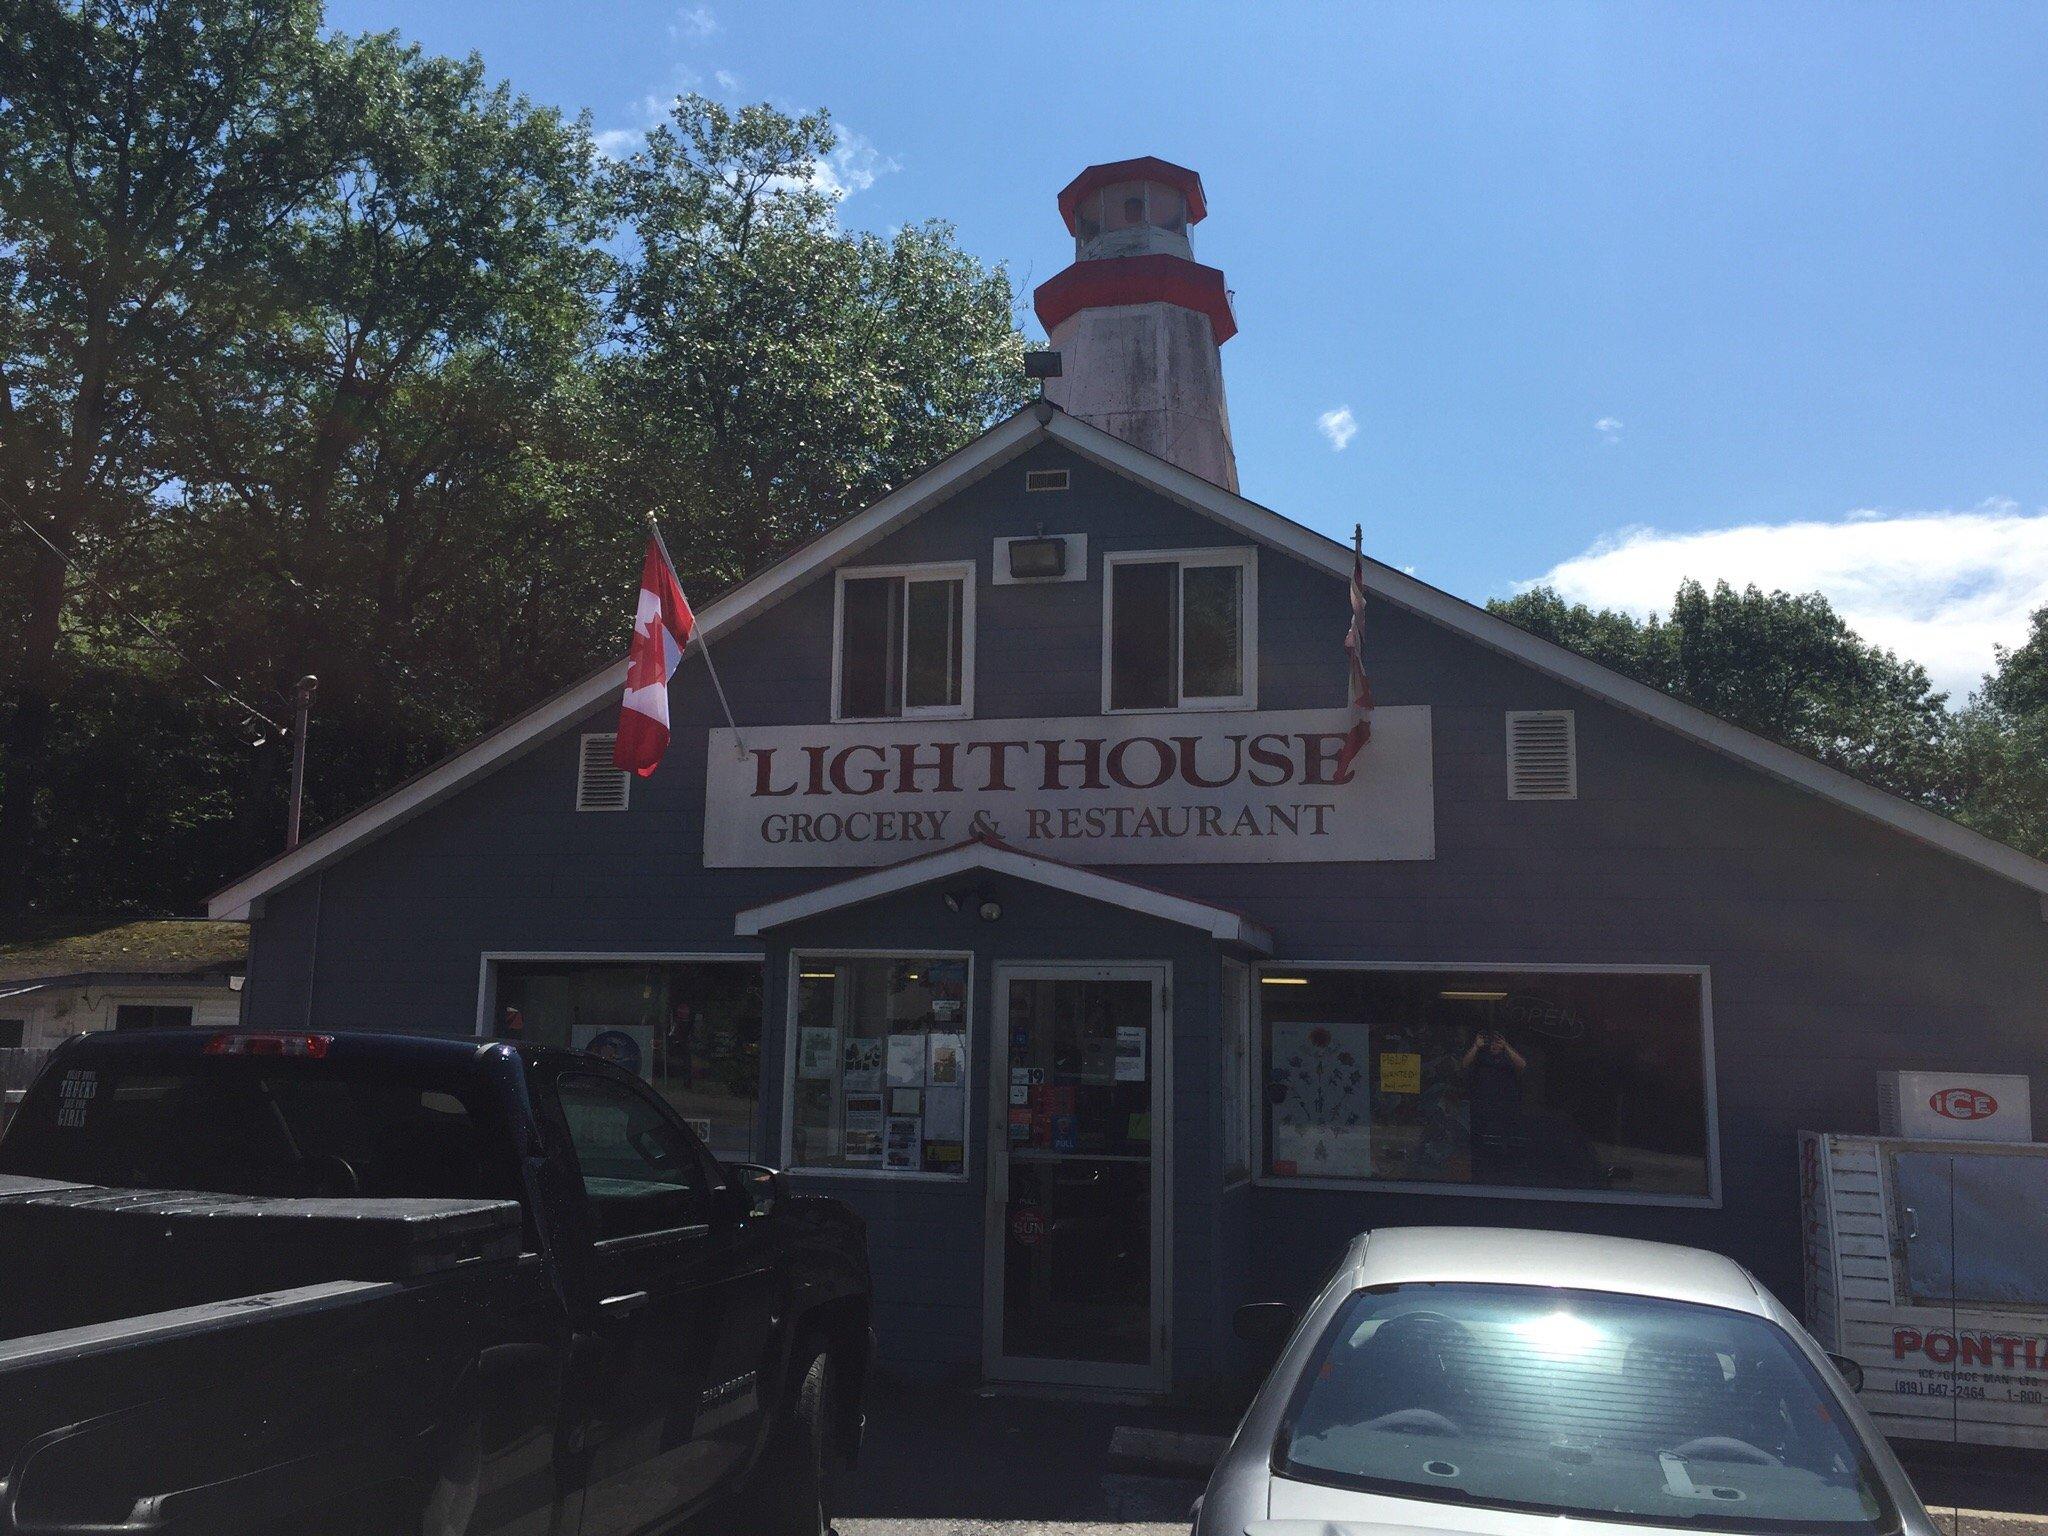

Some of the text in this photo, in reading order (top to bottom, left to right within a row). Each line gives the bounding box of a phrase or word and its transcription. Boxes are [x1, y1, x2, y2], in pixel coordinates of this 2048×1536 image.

[749, 733, 1355, 798] LIGHTHOUSE
[760, 803, 1336, 844] GROCERY & RESTAURANT
[60, 1081, 98, 1098] TRUCKS
[58, 1109, 87, 1126] GIRLS
[1935, 1090, 1992, 1119] ICE
[1892, 1326, 2048, 1370] PONTI
[1895, 1380, 1924, 1396] (819)
[1928, 1382, 1986, 1400] 647-2464
